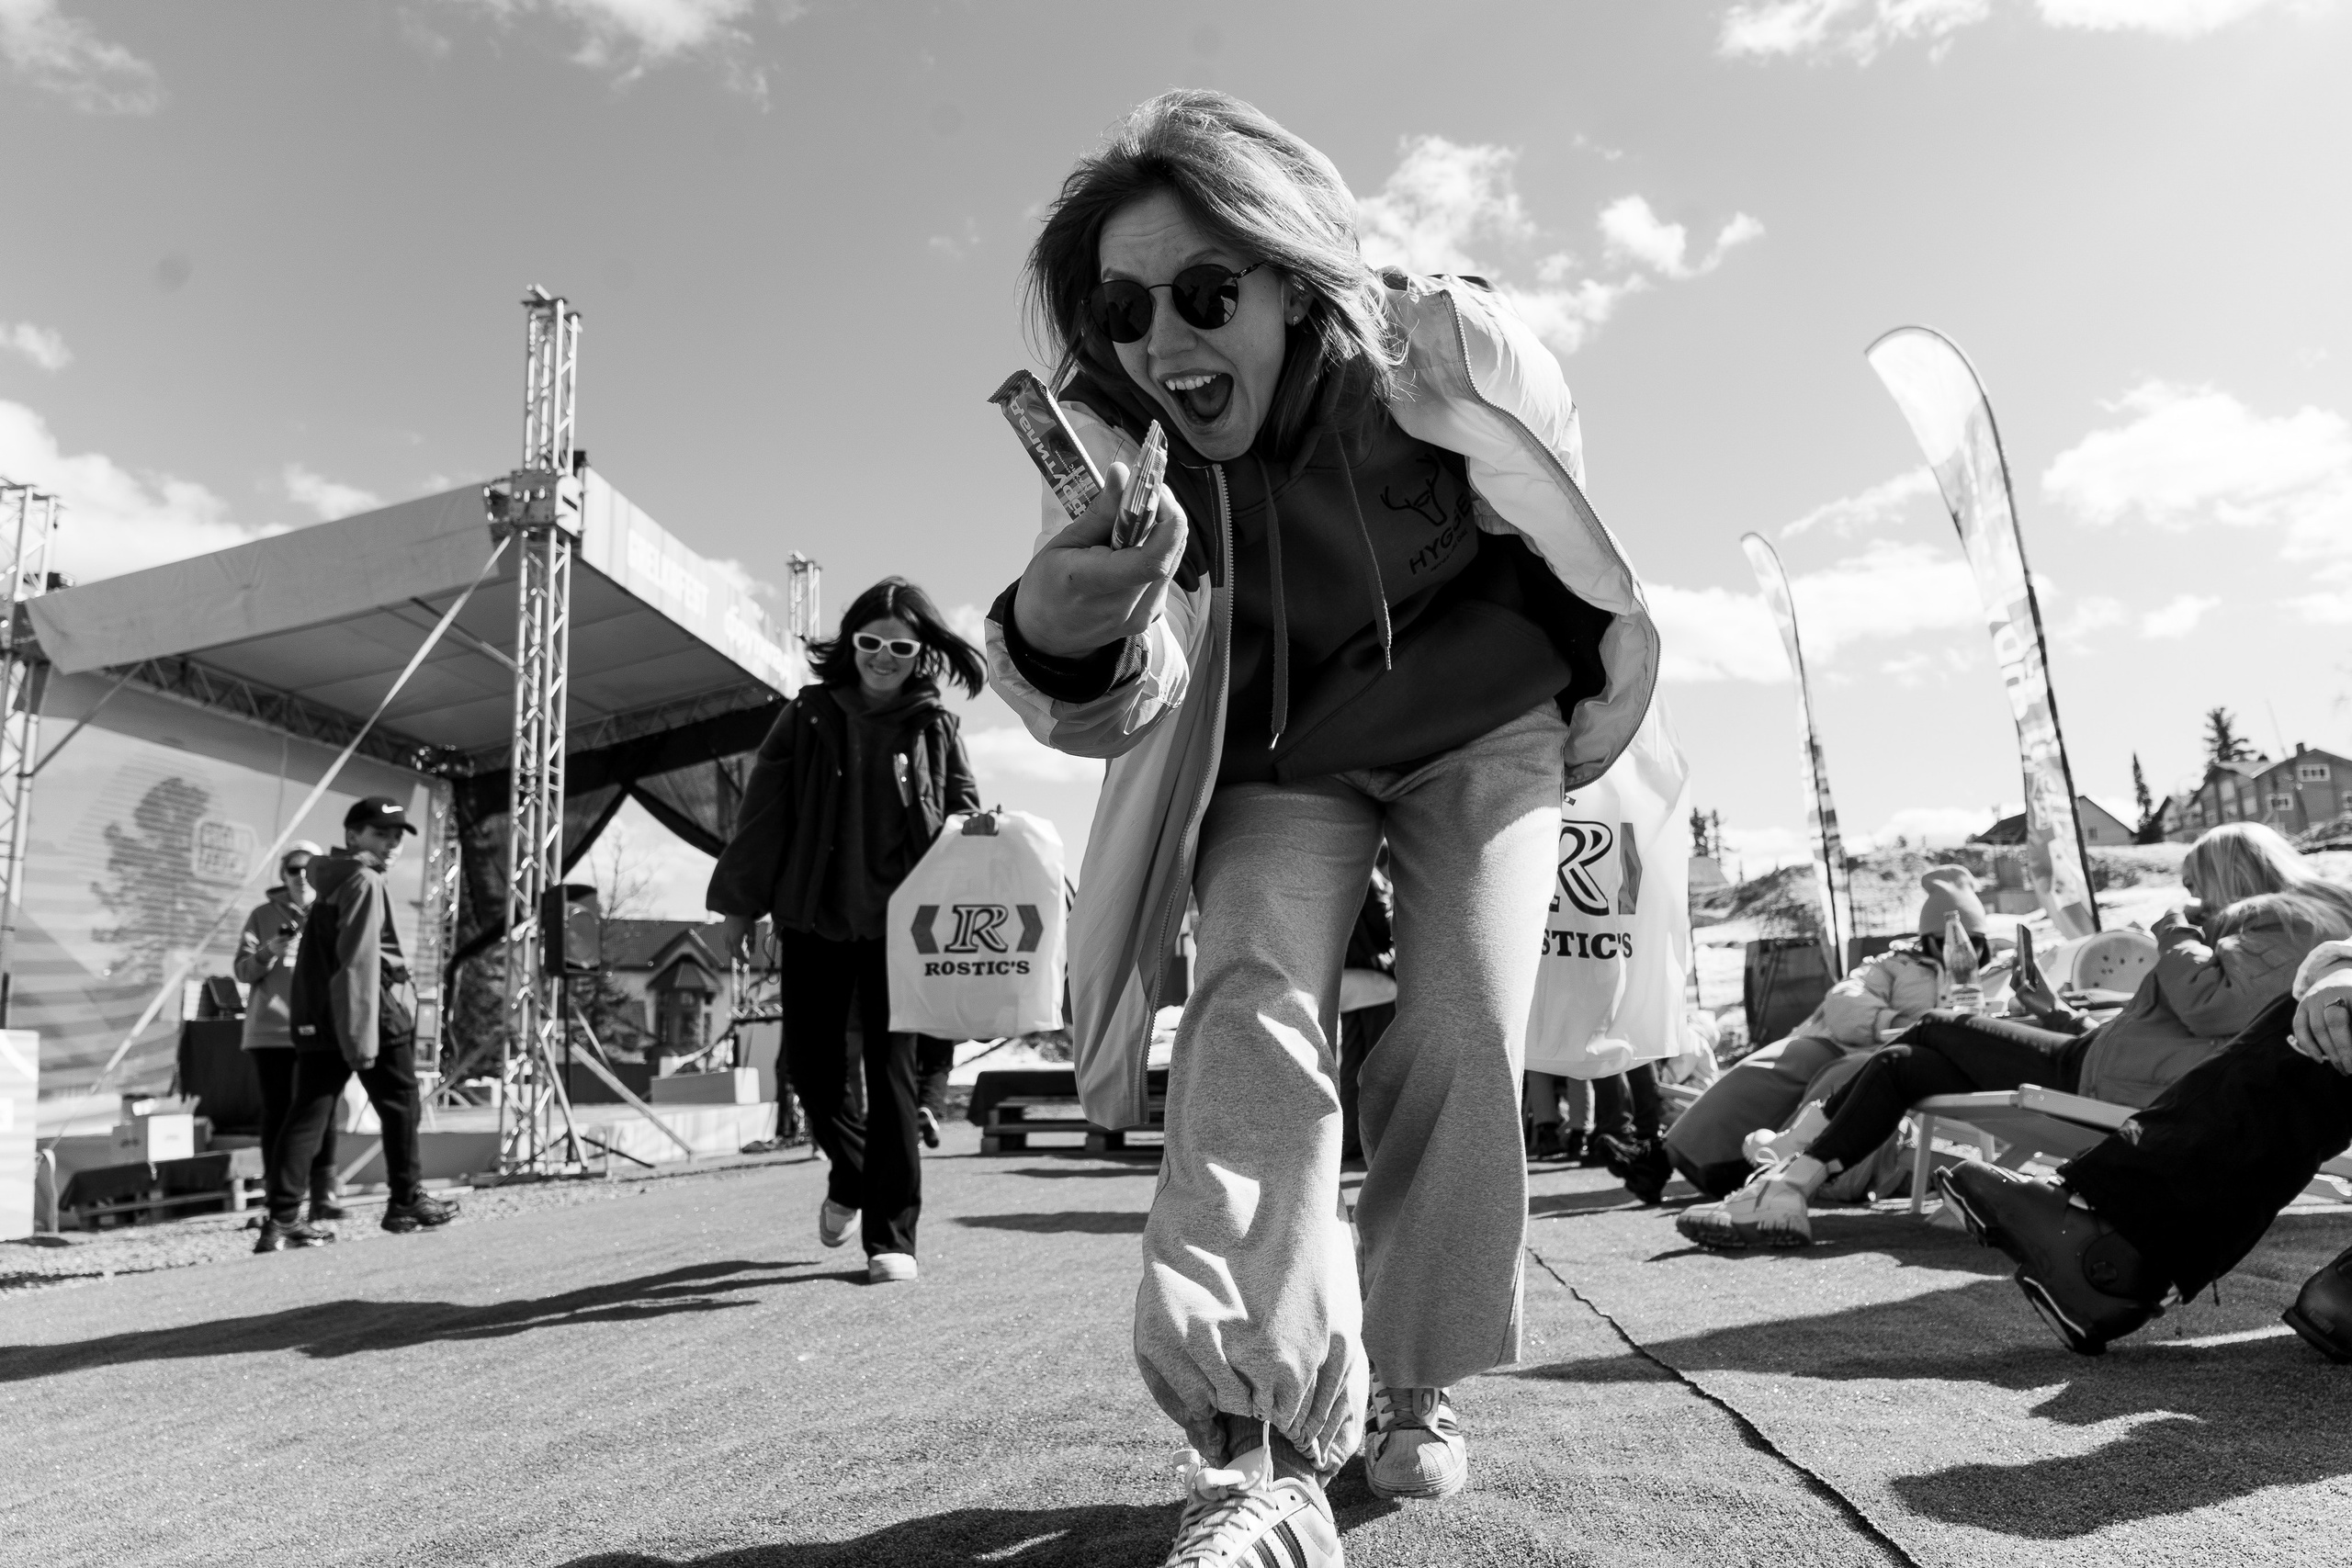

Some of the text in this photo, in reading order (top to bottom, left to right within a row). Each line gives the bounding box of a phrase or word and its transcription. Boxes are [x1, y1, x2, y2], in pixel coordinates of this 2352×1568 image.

[1069, 463, 1090, 492] АРАХИС
[1408, 491, 1471, 575] HYGGE
[944, 904, 1009, 954] R
[1541, 928, 1633, 961] TIC'S
[924, 960, 1031, 977] ROSTIC'S
